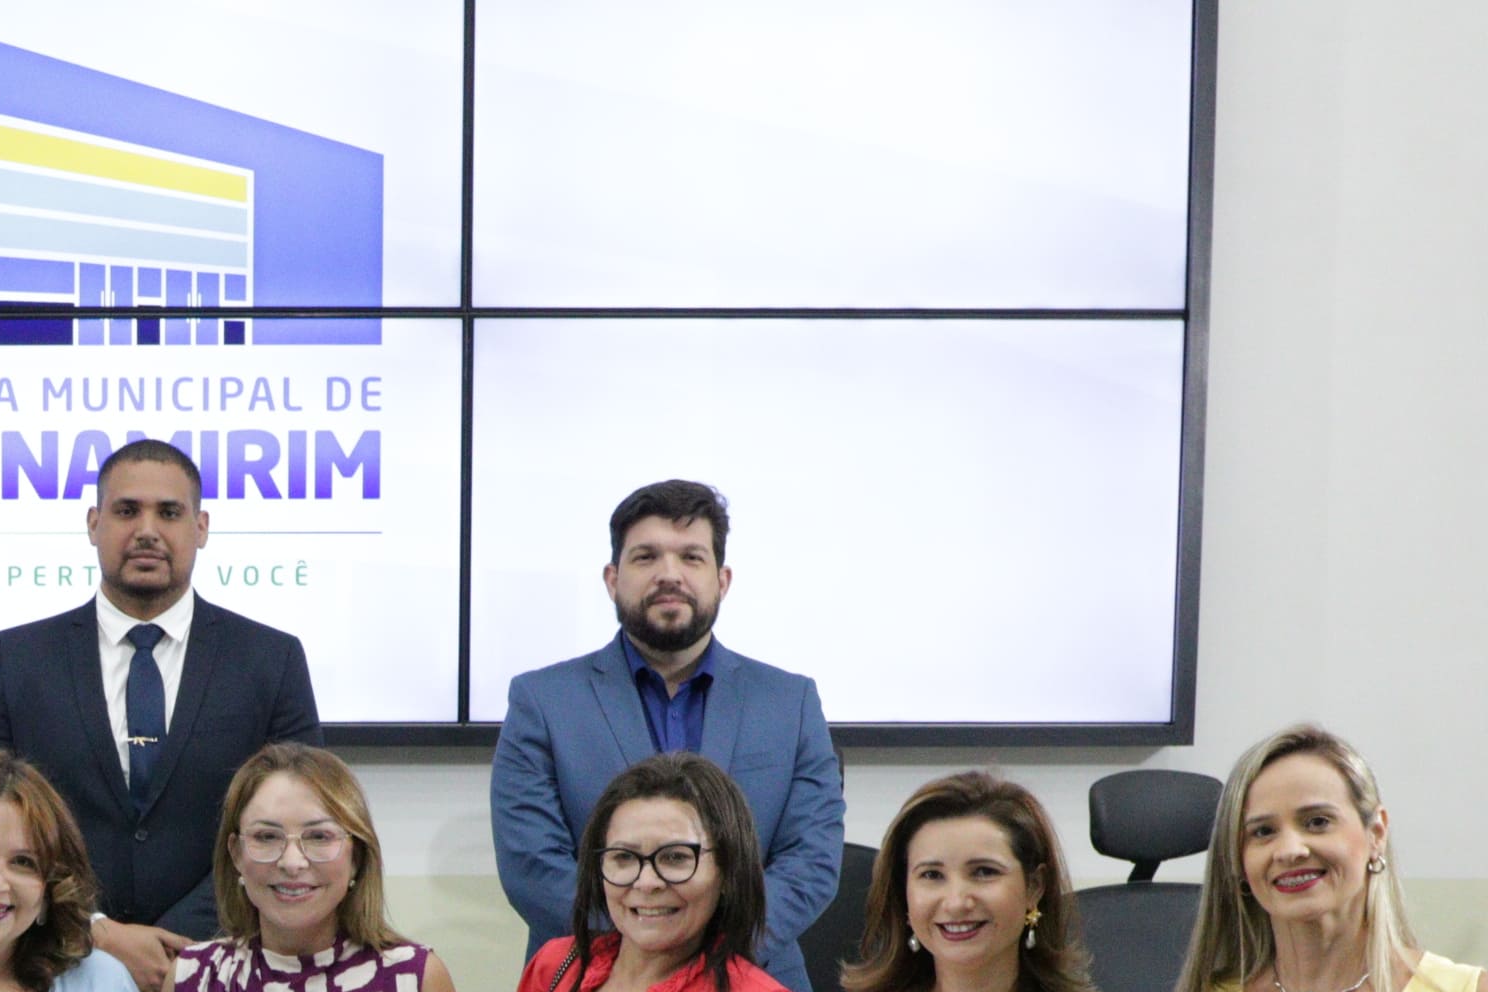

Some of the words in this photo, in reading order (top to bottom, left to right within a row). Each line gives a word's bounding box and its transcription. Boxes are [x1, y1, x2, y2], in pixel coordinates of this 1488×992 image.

[43, 376, 303, 412] MUNICIPAL
[327, 376, 382, 412] DE
[217, 560, 309, 587] VOCÊ
